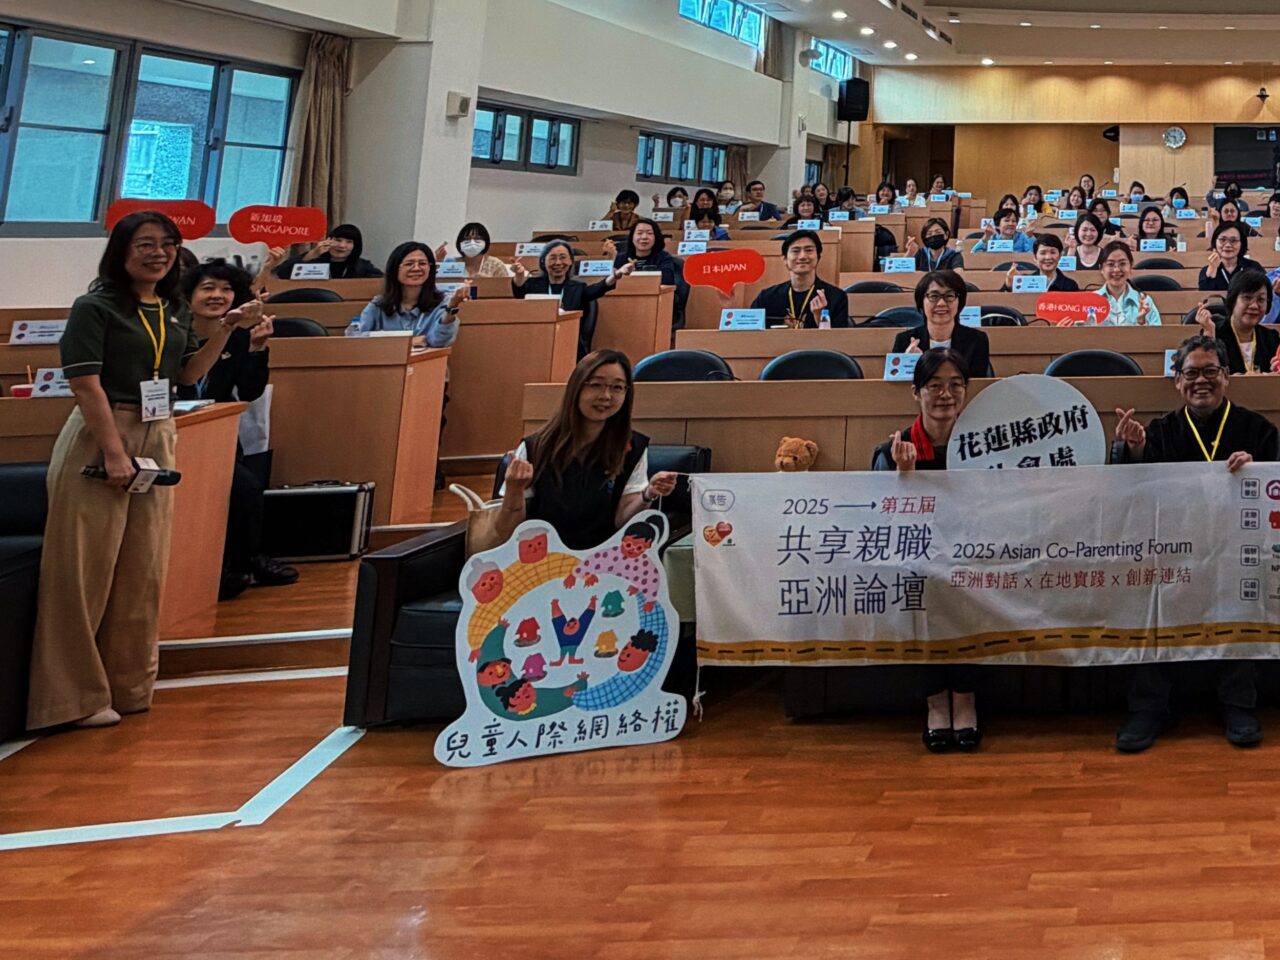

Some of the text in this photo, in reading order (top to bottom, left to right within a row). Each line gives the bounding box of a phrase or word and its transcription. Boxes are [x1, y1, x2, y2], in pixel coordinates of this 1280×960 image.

[168, 215, 196, 226] WAN
[250, 212, 283, 224] 新加坡
[250, 223, 310, 236] SINGAPORE
[1082, 305, 1107, 314] KNG
[954, 404, 1090, 462] 花蓮縣政府
[783, 499, 829, 515] 2025
[880, 496, 936, 515] 第五屆
[777, 523, 932, 566] 共享親職
[952, 539, 1193, 561] 2025 Asian Co-Parenting Forum
[951, 571, 1018, 589] 亞洲對話
[1040, 570, 1105, 589] 在地實踐
[1126, 566, 1192, 586] 創新連結
[778, 571, 928, 617] 亞洲論壇
[447, 699, 679, 762] 兒童人際網絡權
